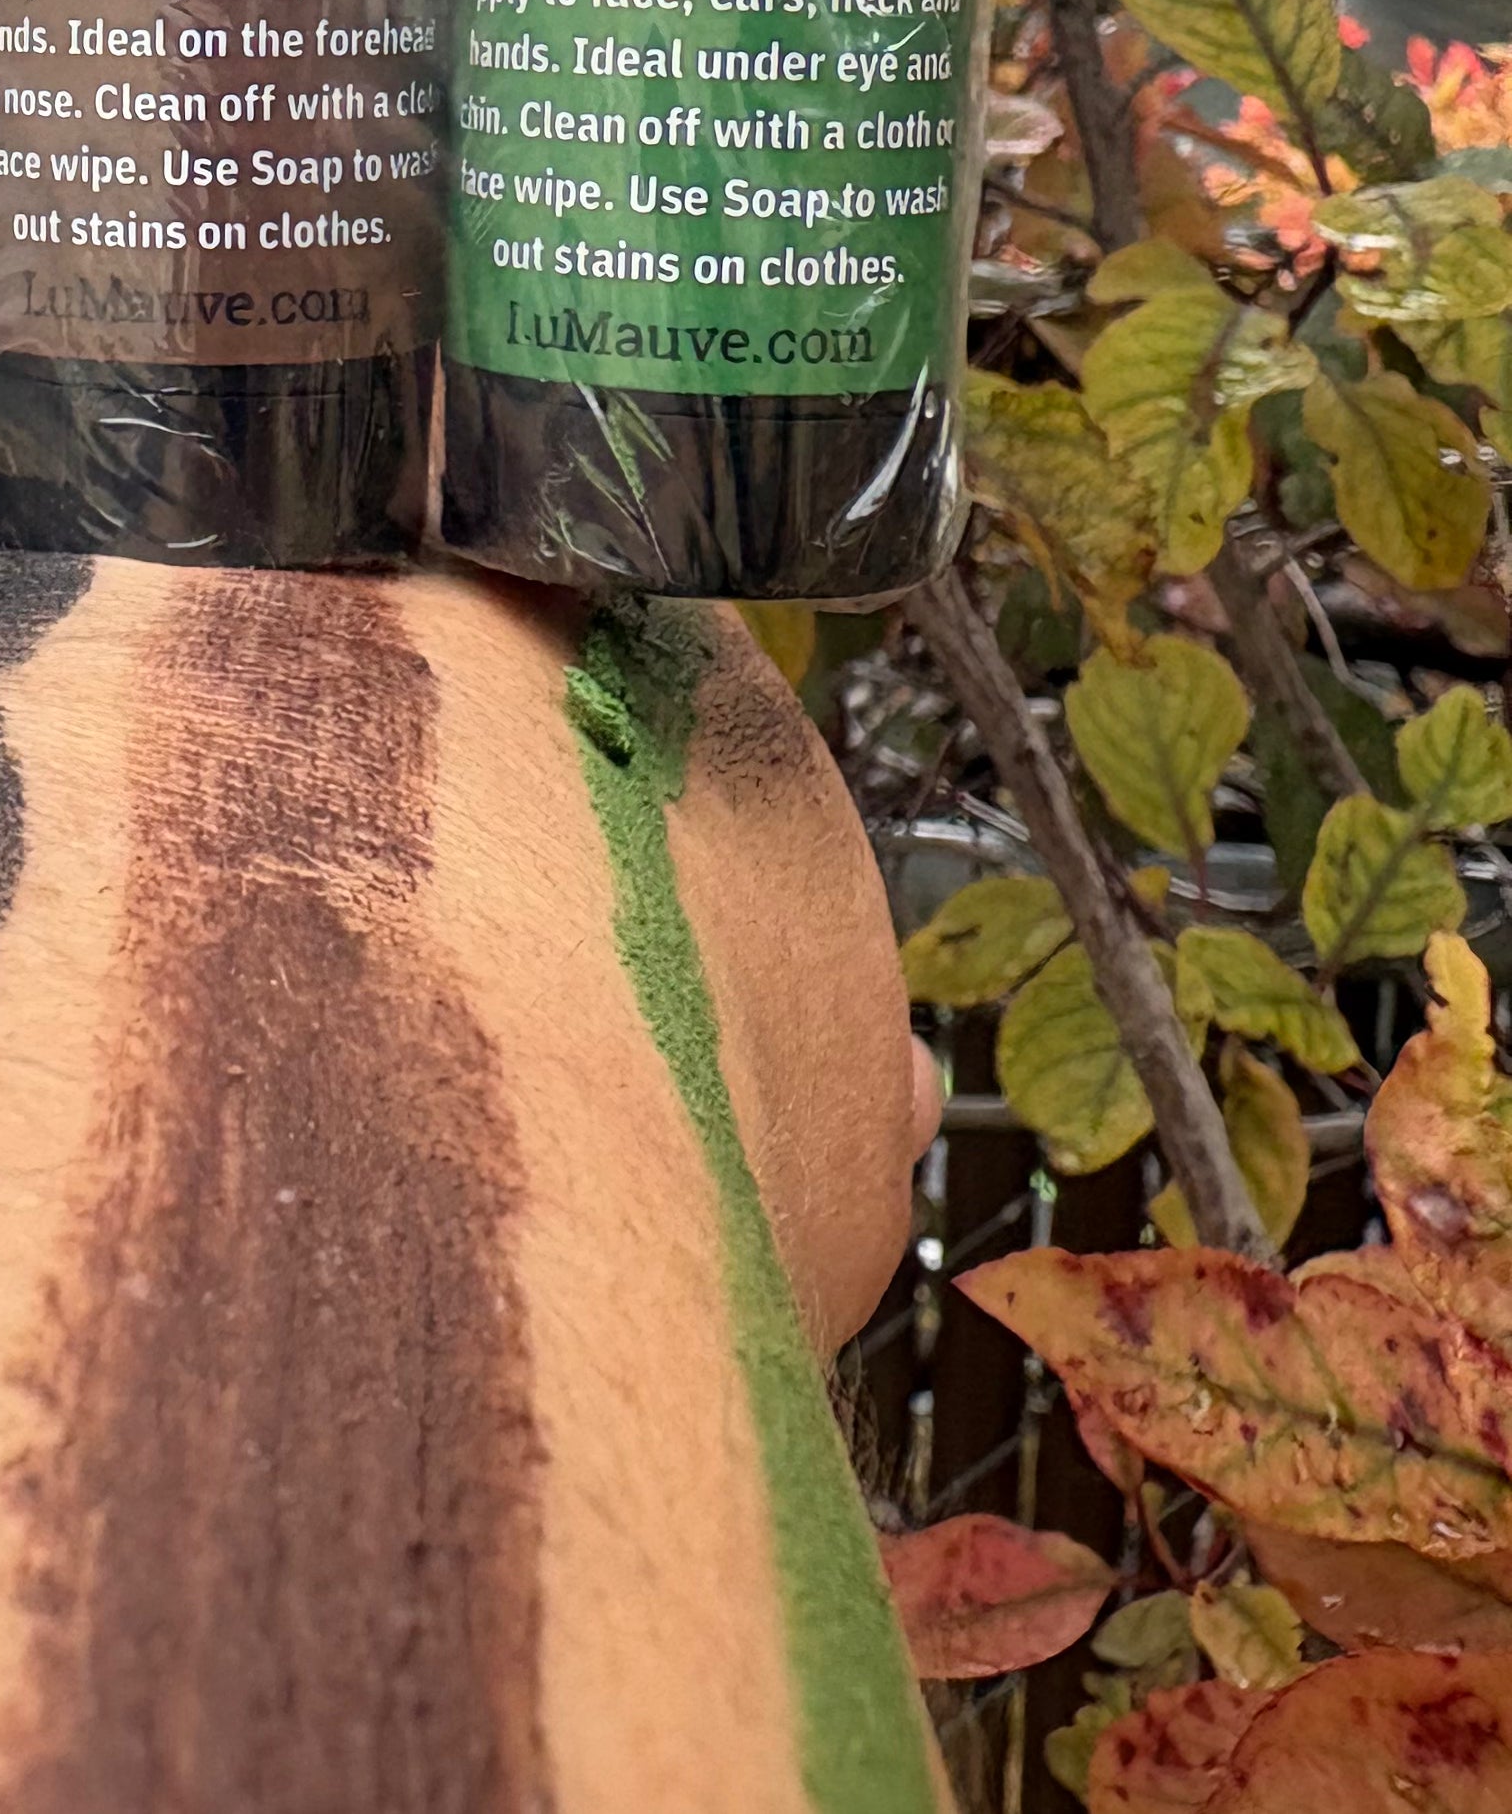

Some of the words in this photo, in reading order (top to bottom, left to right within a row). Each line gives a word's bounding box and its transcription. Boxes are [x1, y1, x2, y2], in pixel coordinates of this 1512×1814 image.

[67, 18, 167, 57] Ideal
[178, 27, 227, 57] on
[241, 19, 304, 57] the
[469, 29, 560, 73] hands.
[573, 36, 683, 79] Ideal
[697, 42, 826, 82] under
[837, 52, 898, 92] eye
[4, 88, 82, 118] nose.
[94, 83, 206, 121] Clean
[220, 83, 276, 121] off
[287, 84, 364, 120] with
[374, 90, 389, 118] a
[460, 95, 508, 135] chin.
[519, 101, 625, 145] Clean
[638, 107, 701, 147] off
[714, 110, 809, 150] with
[823, 119, 845, 150] a
[857, 110, 930, 149] cloth
[50, 145, 149, 192] wipe.
[162, 150, 238, 186] Use
[251, 150, 343, 192] Soap
[353, 149, 382, 182] to
[514, 167, 614, 218] wipe.
[629, 176, 708, 216] Use
[723, 178, 829, 228] Soap
[843, 182, 876, 218] to
[885, 175, 949, 216] wash
[13, 209, 61, 243] out
[71, 210, 187, 250] stains
[198, 221, 246, 250] on
[258, 210, 392, 250] clothes.
[493, 236, 544, 272] out
[554, 240, 679, 284] stains
[693, 256, 745, 285] on
[760, 246, 905, 286] clothes.
[23, 270, 370, 326] LuMauve.com
[506, 301, 877, 364] LuMauve.com
